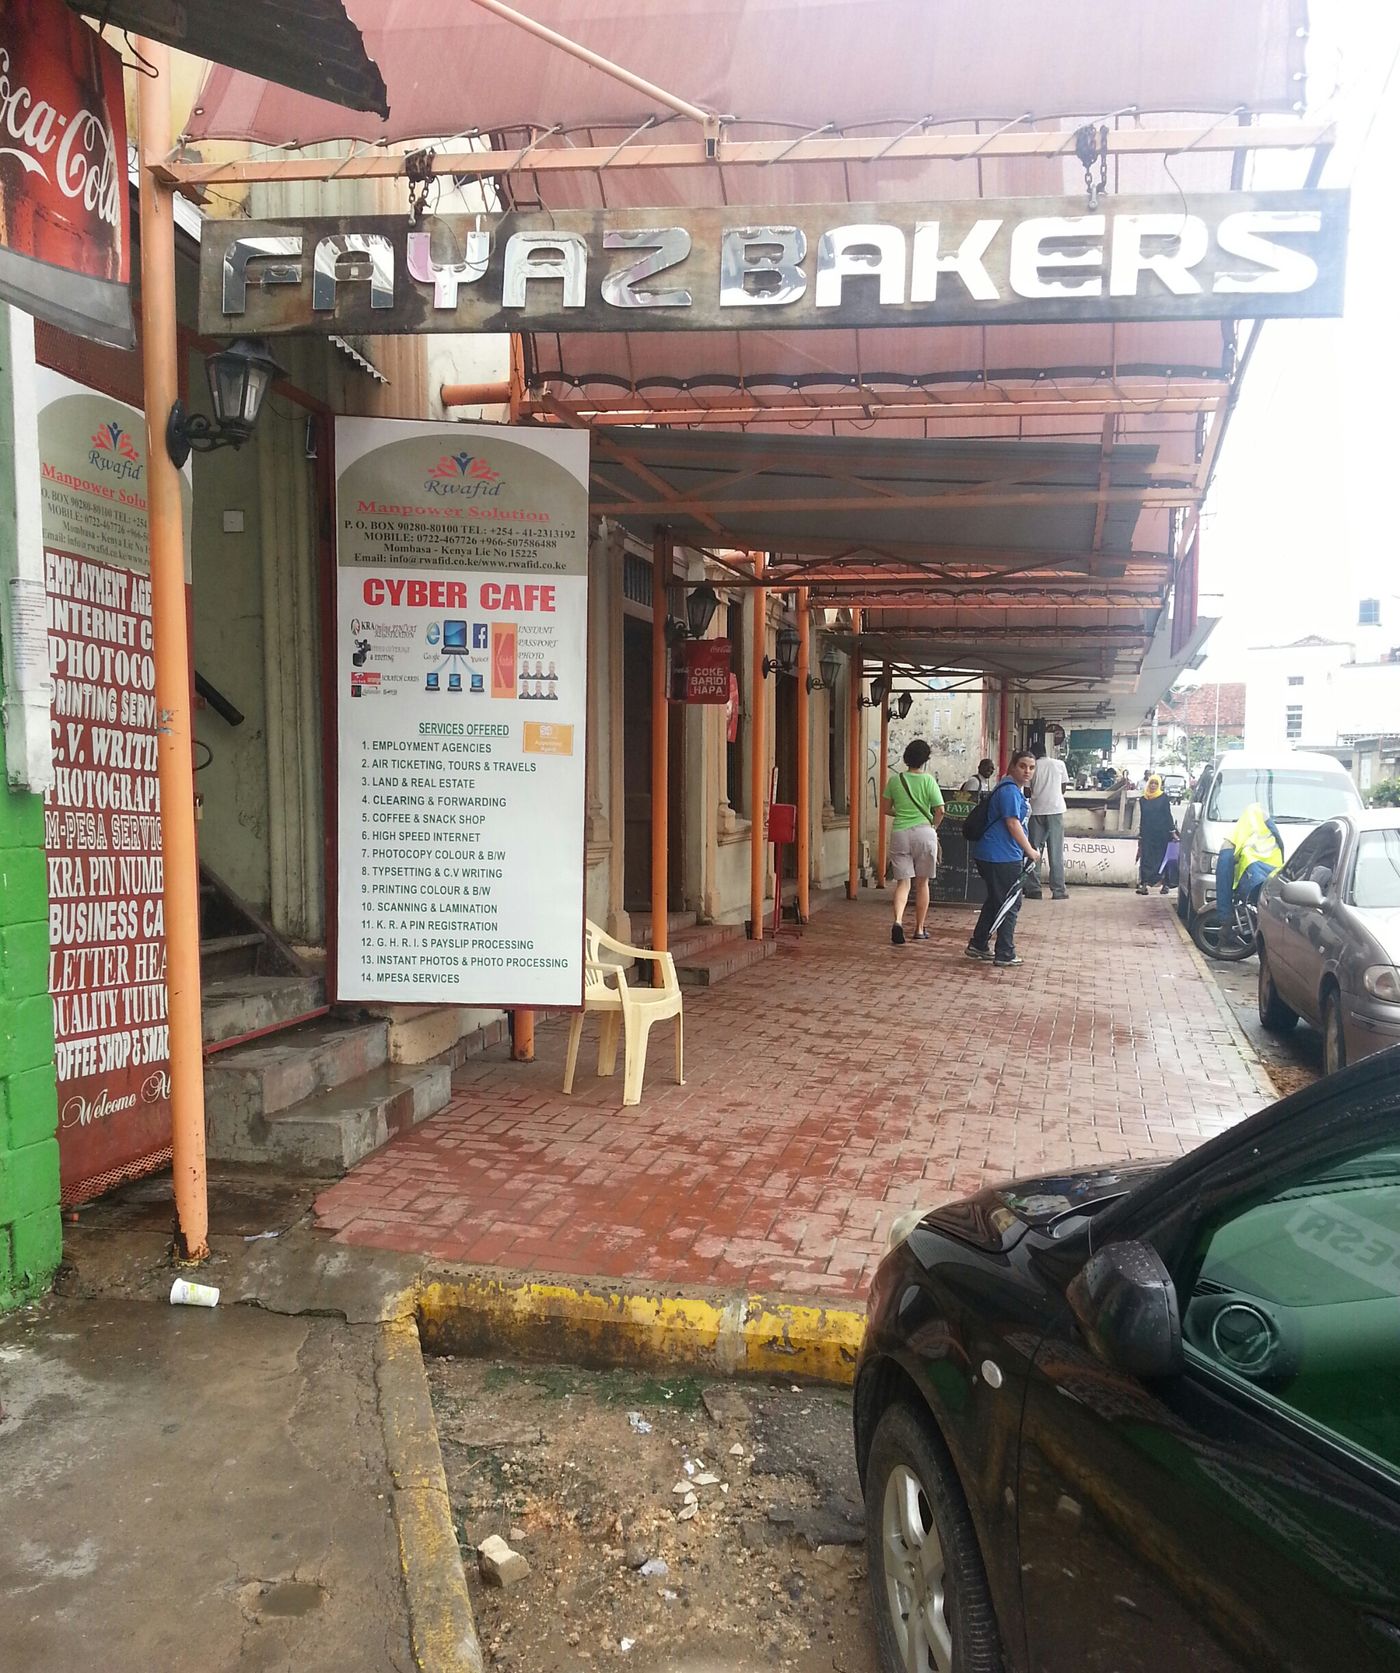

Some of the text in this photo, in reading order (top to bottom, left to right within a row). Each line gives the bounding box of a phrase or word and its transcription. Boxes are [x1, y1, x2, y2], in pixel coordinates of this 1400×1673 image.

[223, 211, 1321, 314] FAYAZ BAKERS
[88, 449, 144, 480] Rwafid
[41, 462, 116, 499] Manpower
[424, 480, 506, 499] Rwafid
[52, 491, 69, 505] BOX
[48, 502, 83, 522] MOBILE:
[356, 500, 551, 521] Manpower Solution
[370, 521, 395, 531] BOX
[397, 522, 459, 533] 90280-80100
[461, 525, 488, 535] TEL:
[490, 527, 513, 537] +254
[522, 529, 576, 538] 41-2313192
[364, 532, 414, 543] MOBILE:
[416, 534, 478, 545] 0722-467726
[384, 543, 432, 554] Mombasa
[441, 546, 472, 557] Kenya
[493, 549, 507, 558] No
[509, 549, 538, 558] 15225
[354, 553, 387, 563] Email:
[46, 552, 127, 611] EMPLOYMENT
[363, 578, 556, 612] CYBER CAFE
[46, 595, 137, 647] INTERNET
[140, 619, 154, 650] C
[518, 626, 554, 634] INSTANT
[518, 640, 558, 648] PASSPORT
[48, 635, 156, 691] PHOTOCO
[694, 667, 724, 677] COKE
[691, 676, 727, 686] BARIDI
[693, 685, 723, 695] HAPA
[50, 676, 117, 724] PRINTING
[419, 722, 509, 736] SERVICES OFFERED
[361, 740, 492, 753] 1. EMPLOYMENT AGENCIES
[361, 759, 537, 772] 2. AIR TICKETING, TOURS & TRAVELS
[361, 777, 475, 788] 3. LAND & REAL ESTATE
[361, 795, 507, 807] 4. CLEARING & FORWARDING
[361, 813, 486, 824] 5. COFFEE & SNACK SHOP
[45, 811, 108, 850] M-PESA
[361, 831, 481, 842] 6. HIGH SPEED INTERNET
[361, 849, 506, 860] 7. PHOTOCOPY COLOUR & B/W
[1072, 843, 1115, 854] SABABU
[1064, 859, 1087, 869] OMA
[47, 857, 86, 898] KRA
[88, 856, 116, 897] PIN
[361, 867, 503, 878] 8. TYPSETTING & C.V WRITING
[361, 884, 491, 895] 9. PRINTING COLOUR & B/W
[361, 902, 497, 913] 10. SCANNING & LAMINATION
[50, 899, 166, 946] BUSINESS CA
[361, 920, 374, 929] 11.
[409, 921, 425, 930] PIN
[428, 921, 498, 931] REGISTRATION
[361, 938, 374, 947] 12.
[430, 939, 469, 948] PAYSLIP
[472, 940, 534, 949] PROCESSING
[361, 955, 568, 968] 13. INSTANT PHOTOS & PHOTO PROCESSING
[48, 944, 130, 993] LETTER
[361, 973, 460, 983] 14. MPESA SERVICES
[122, 983, 169, 1025] TUITI
[55, 1037, 98, 1082] OFFEE
[99, 1031, 131, 1074] SHOP
[132, 1029, 141, 1066] &
[62, 1088, 136, 1128] Welcome
